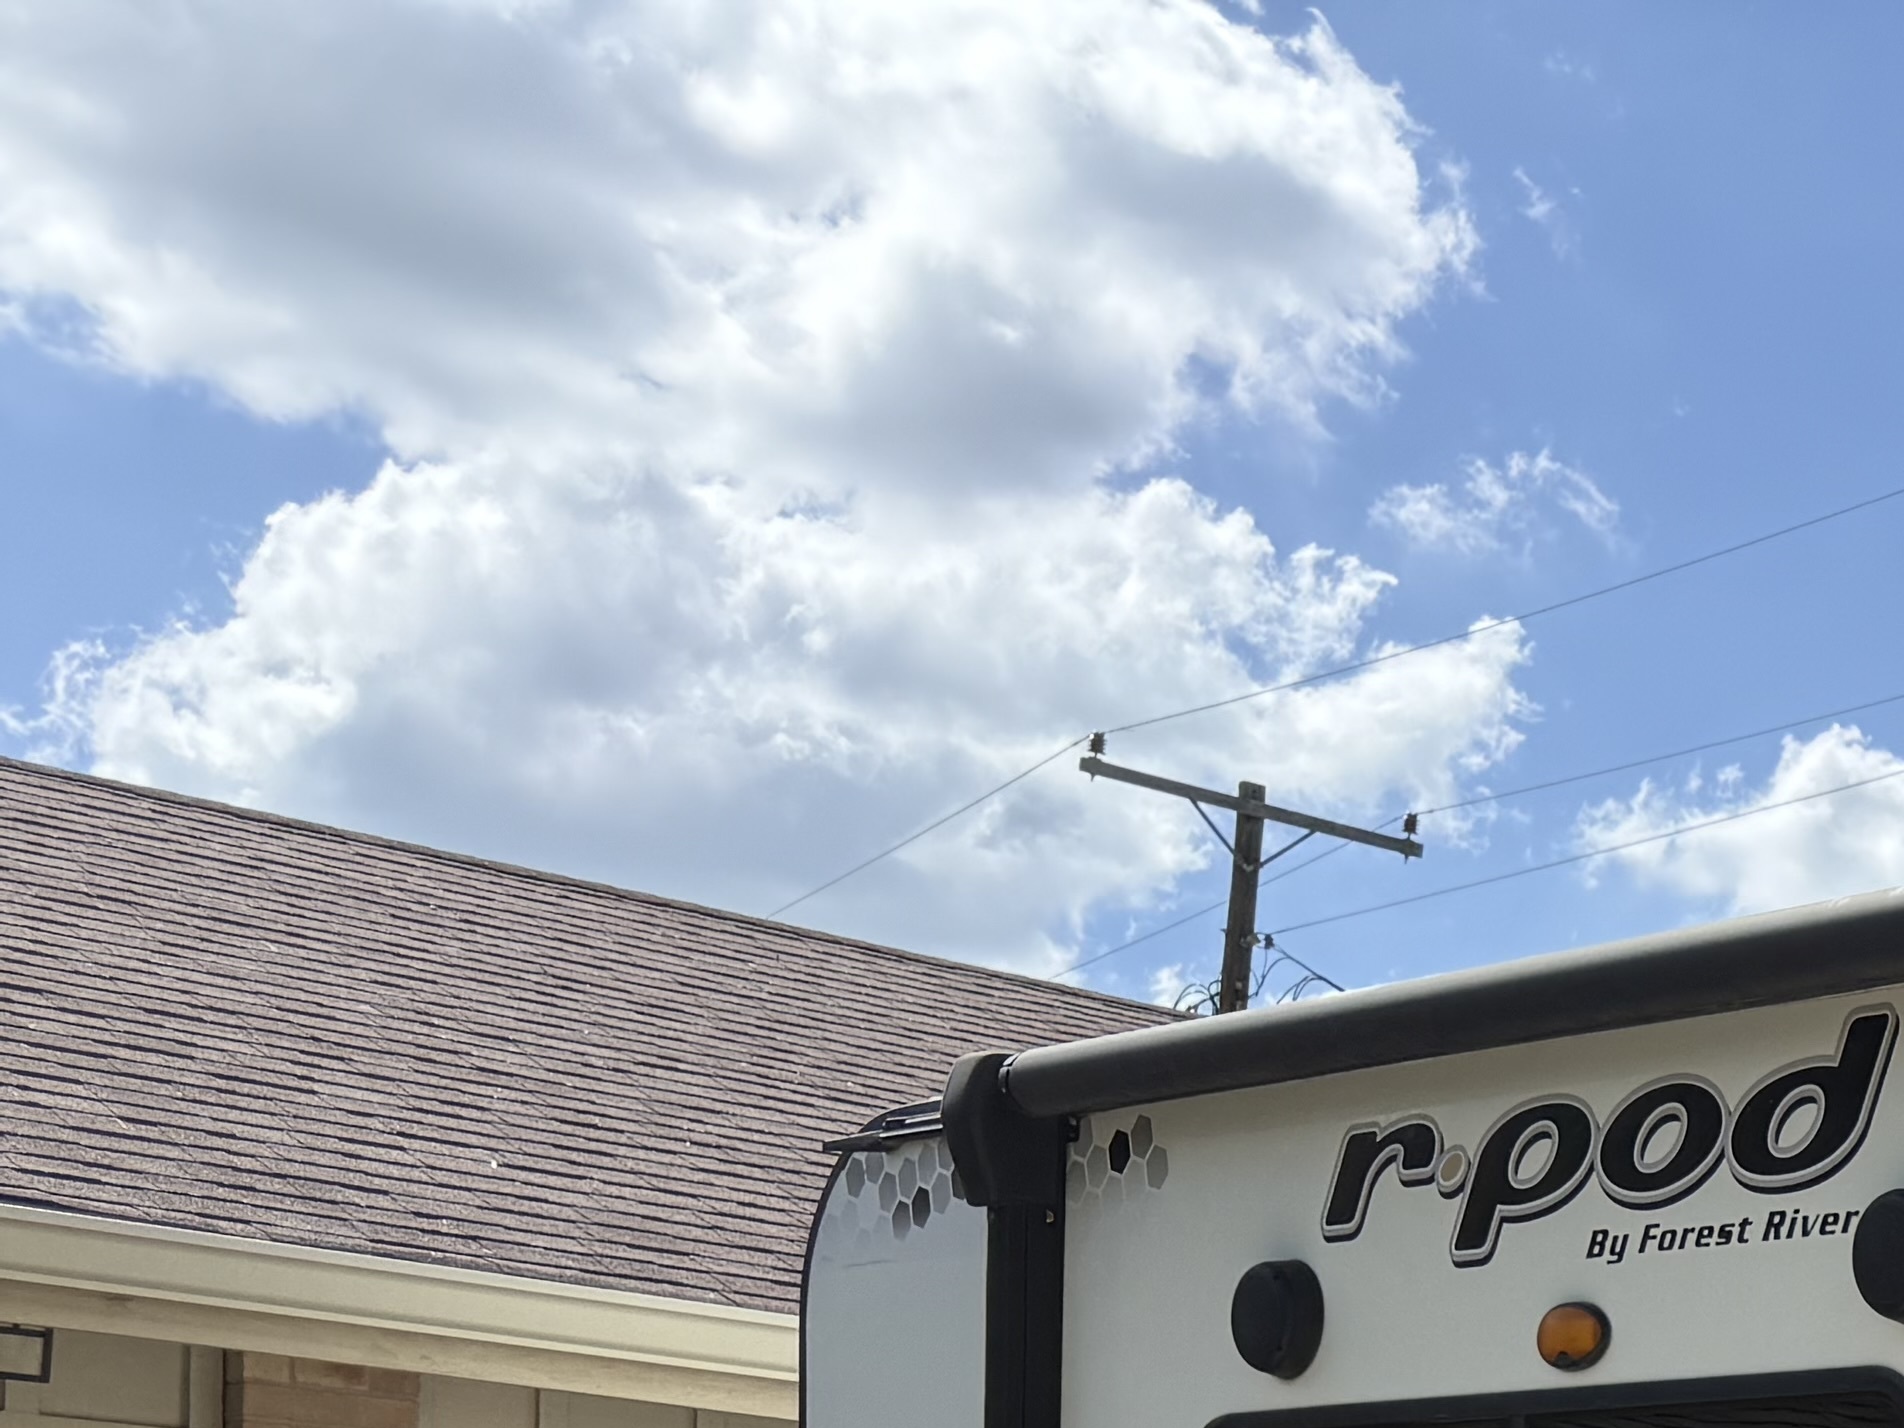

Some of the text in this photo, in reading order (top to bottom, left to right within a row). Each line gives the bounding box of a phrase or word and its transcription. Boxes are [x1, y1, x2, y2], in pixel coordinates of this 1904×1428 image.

[1586, 1208, 1860, 1265] By Forest River
